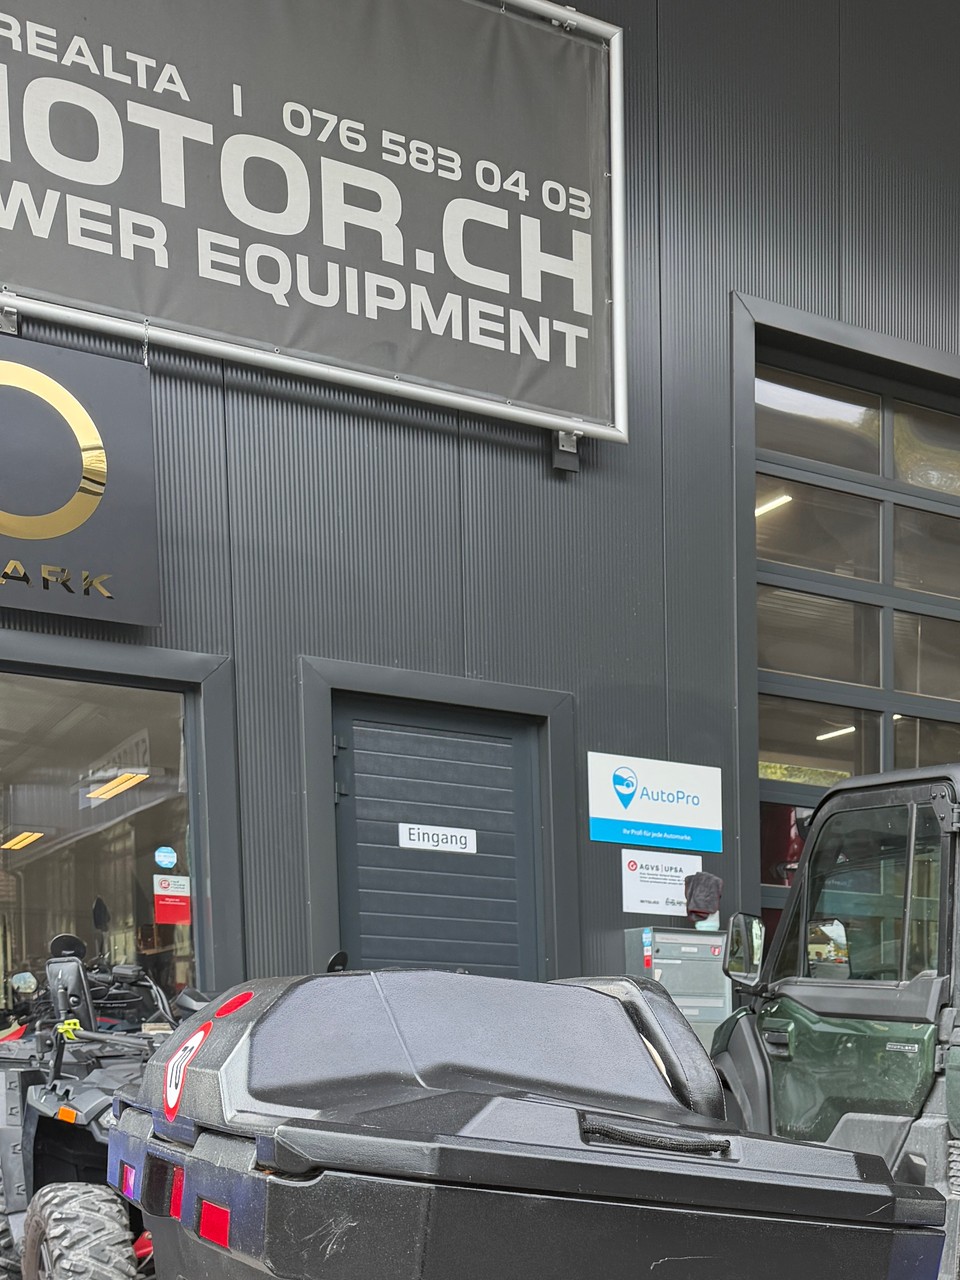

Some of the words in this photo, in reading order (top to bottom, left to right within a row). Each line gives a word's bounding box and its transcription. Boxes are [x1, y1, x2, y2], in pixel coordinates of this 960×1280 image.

[283, 101, 367, 153] 076
[382, 130, 462, 182] 583
[475, 160, 530, 201] 04
[542, 180, 592, 220] 03
[0, 62, 592, 316] OTOR.CH
[197, 228, 589, 369] EQUIPMENT
[0, 559, 115, 600] ARK
[640, 786, 701, 807] AutoPro
[408, 827, 468, 850] Eingang
[640, 863, 660, 871] AGVS
